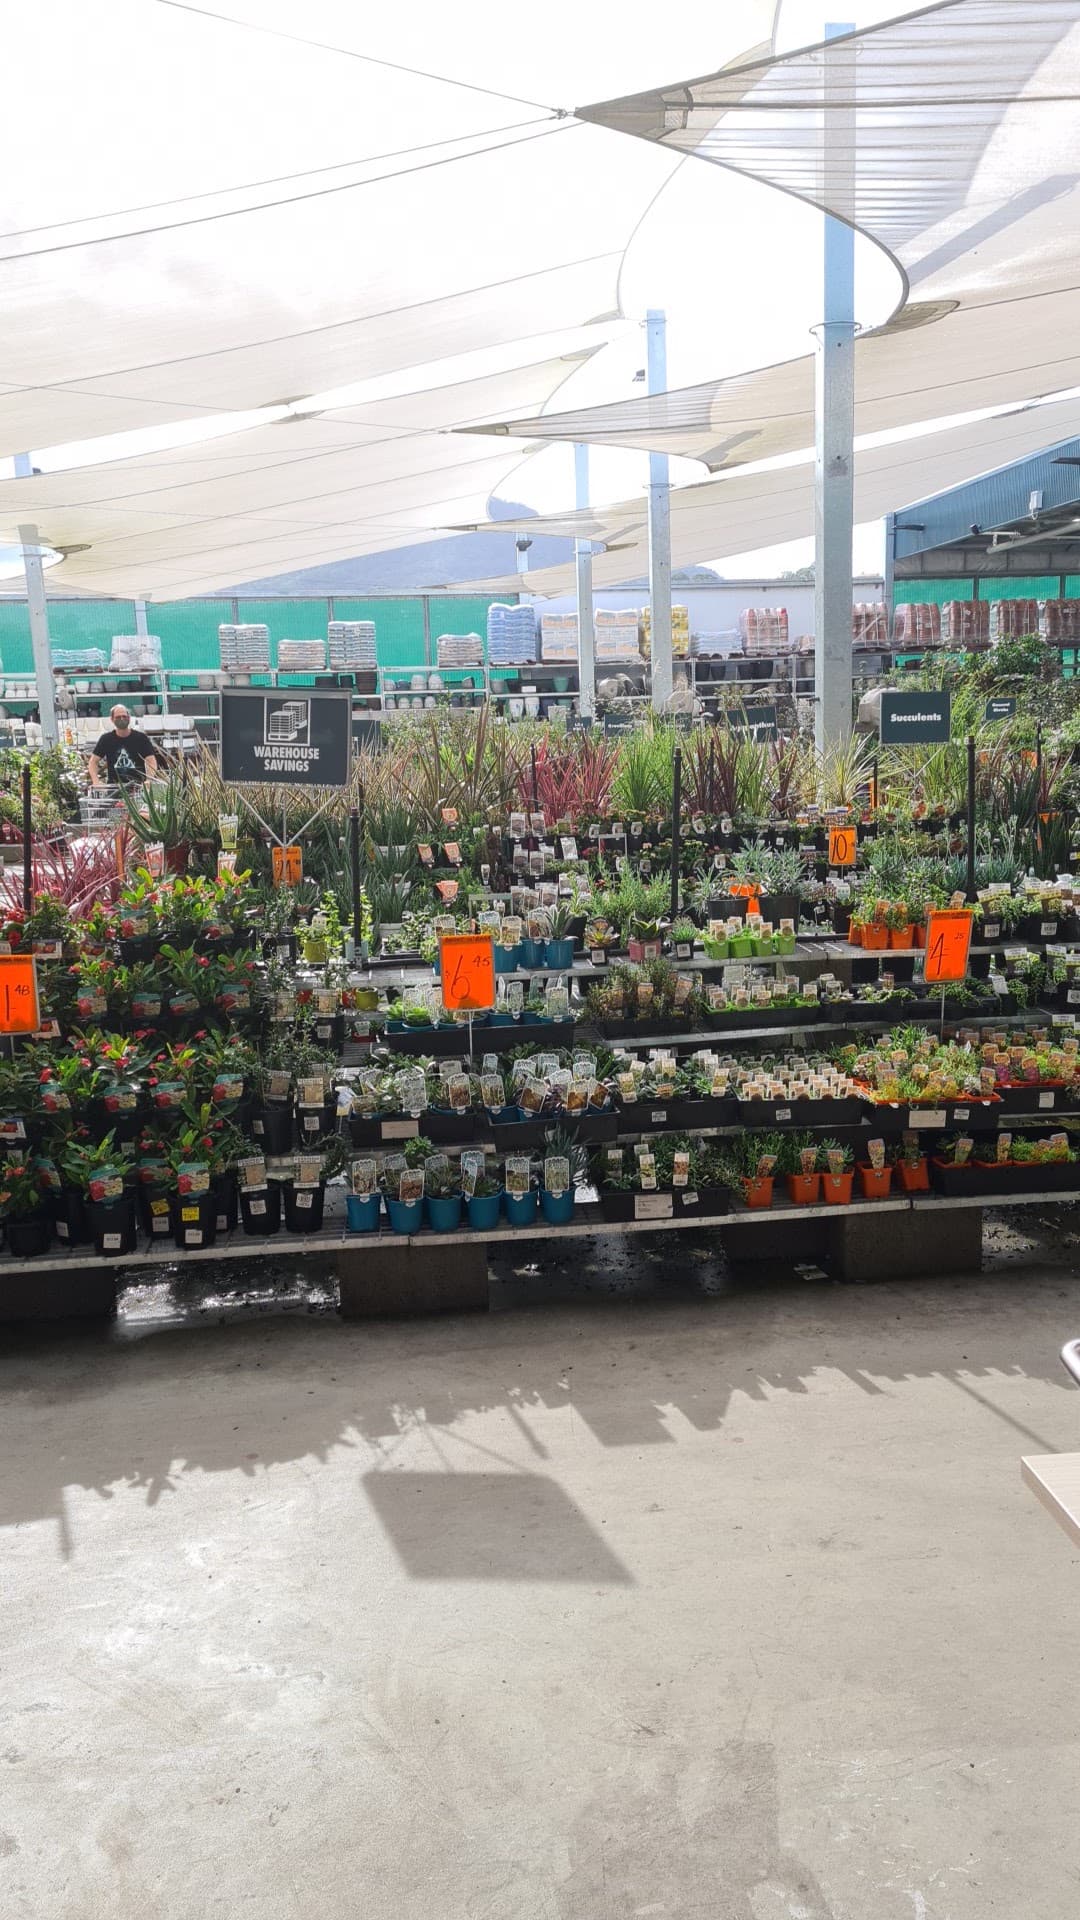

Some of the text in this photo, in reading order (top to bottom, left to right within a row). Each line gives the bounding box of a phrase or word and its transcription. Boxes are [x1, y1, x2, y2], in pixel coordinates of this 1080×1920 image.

[890, 712, 942, 722] Succulents
[253, 745, 320, 760] WAREHOUSE
[263, 759, 310, 772] SAVINGS
